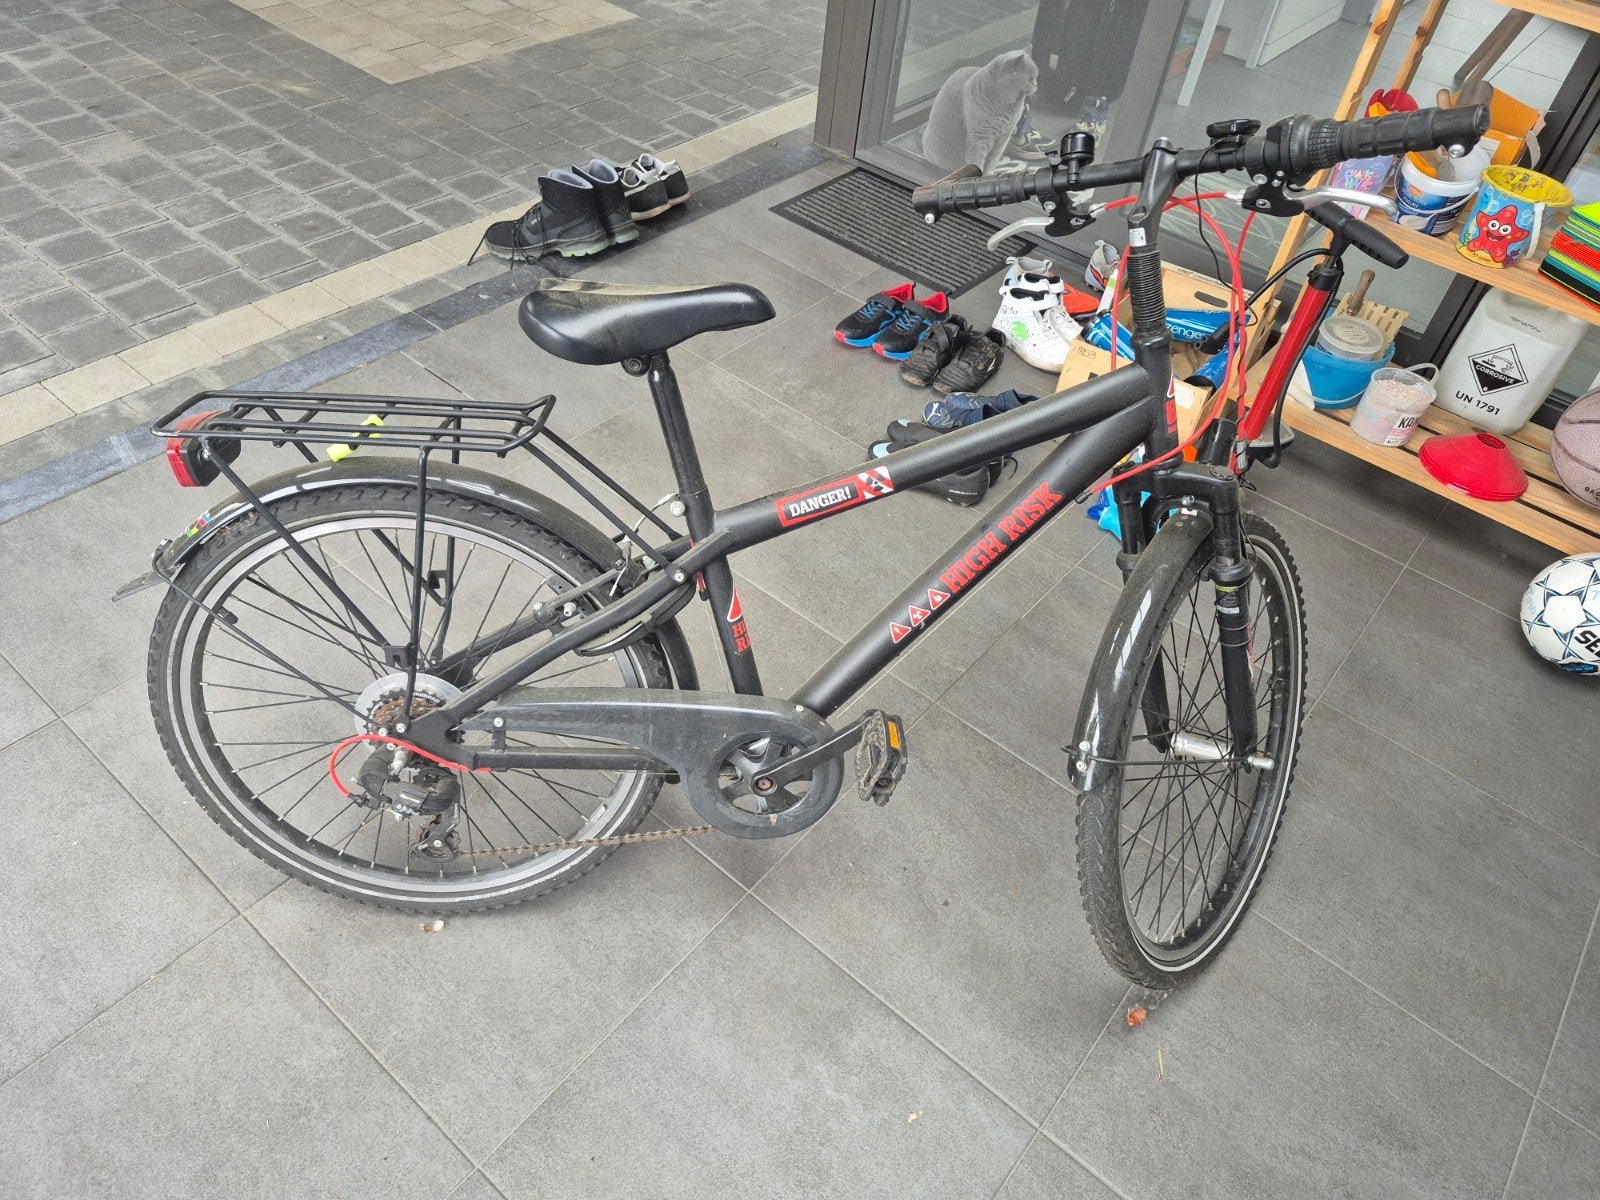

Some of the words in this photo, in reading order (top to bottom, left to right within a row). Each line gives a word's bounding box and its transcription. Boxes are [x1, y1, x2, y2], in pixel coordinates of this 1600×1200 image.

[1475, 364, 1515, 384] CORROSIVE
[1455, 390, 1474, 404] UN
[1476, 399, 1501, 416] 1791
[788, 486, 852, 517] DANGER!
[940, 531, 1007, 594] HIGH
[997, 481, 1063, 541] RISK
